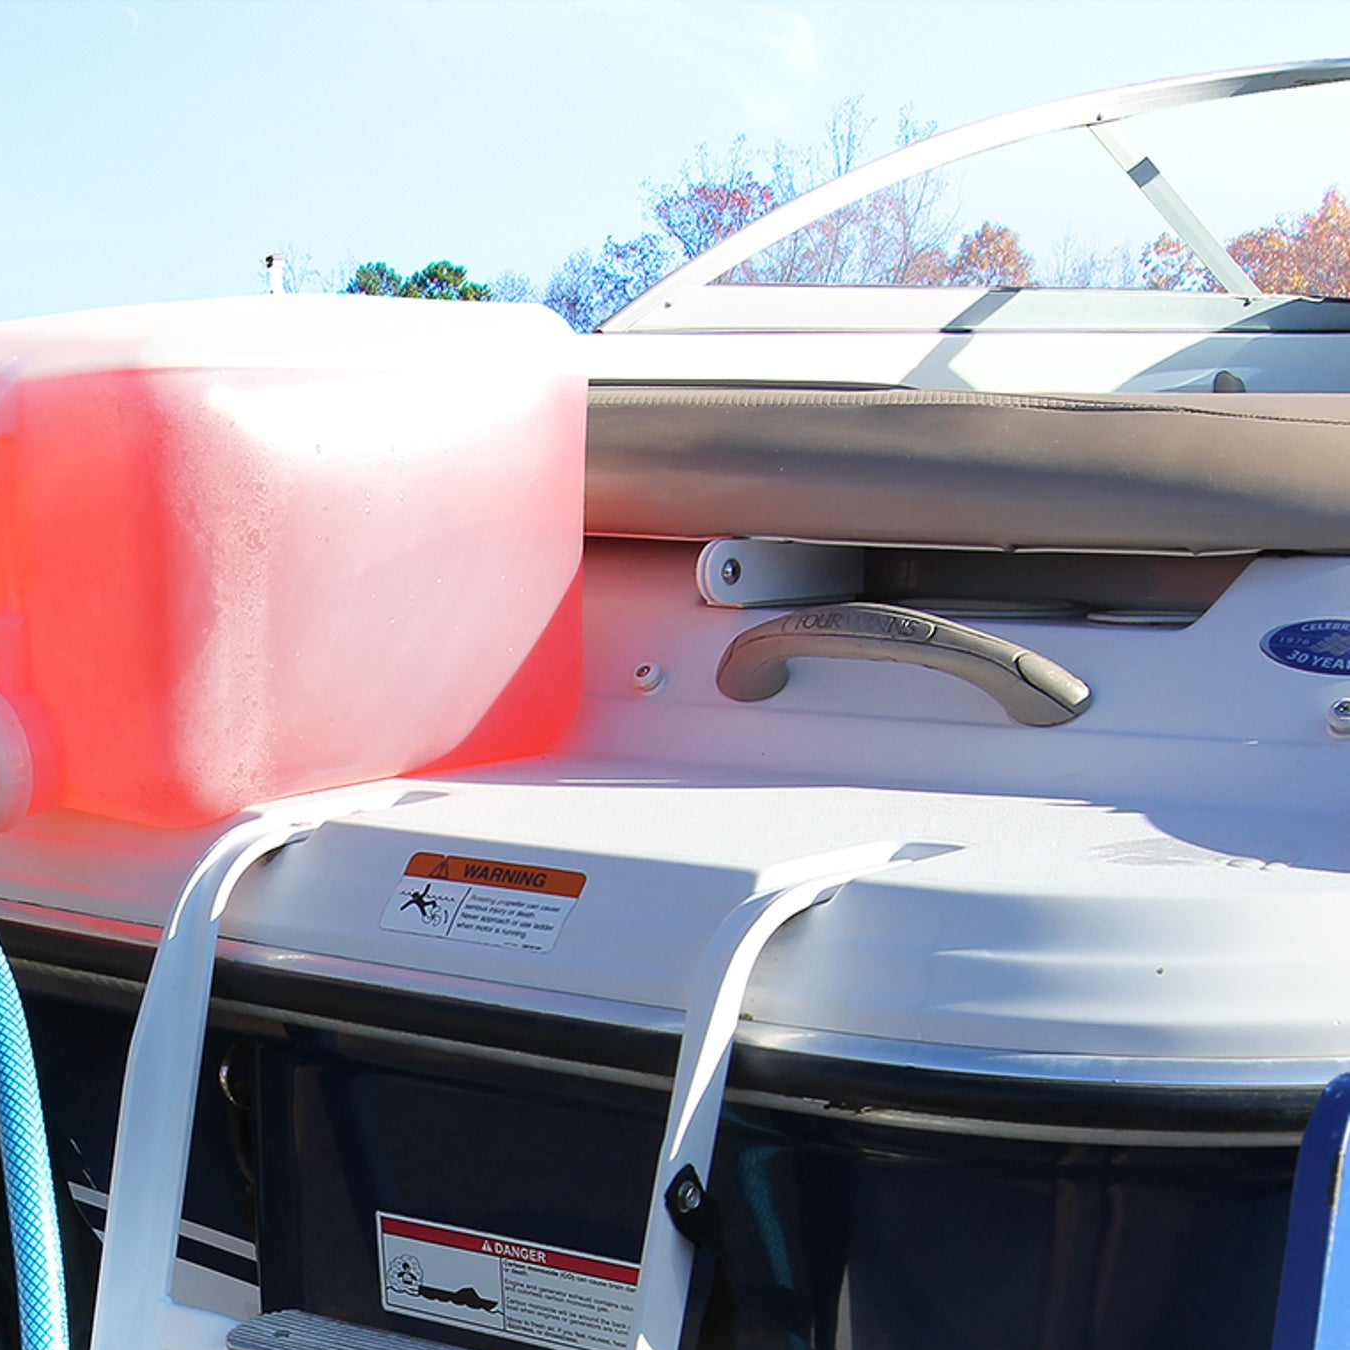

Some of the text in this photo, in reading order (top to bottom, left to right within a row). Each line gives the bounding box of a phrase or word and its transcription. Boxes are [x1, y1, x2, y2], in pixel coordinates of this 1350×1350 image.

[1285, 649, 1310, 664] 30
[463, 863, 548, 888] WARNING
[494, 1242, 547, 1264] DANGER
